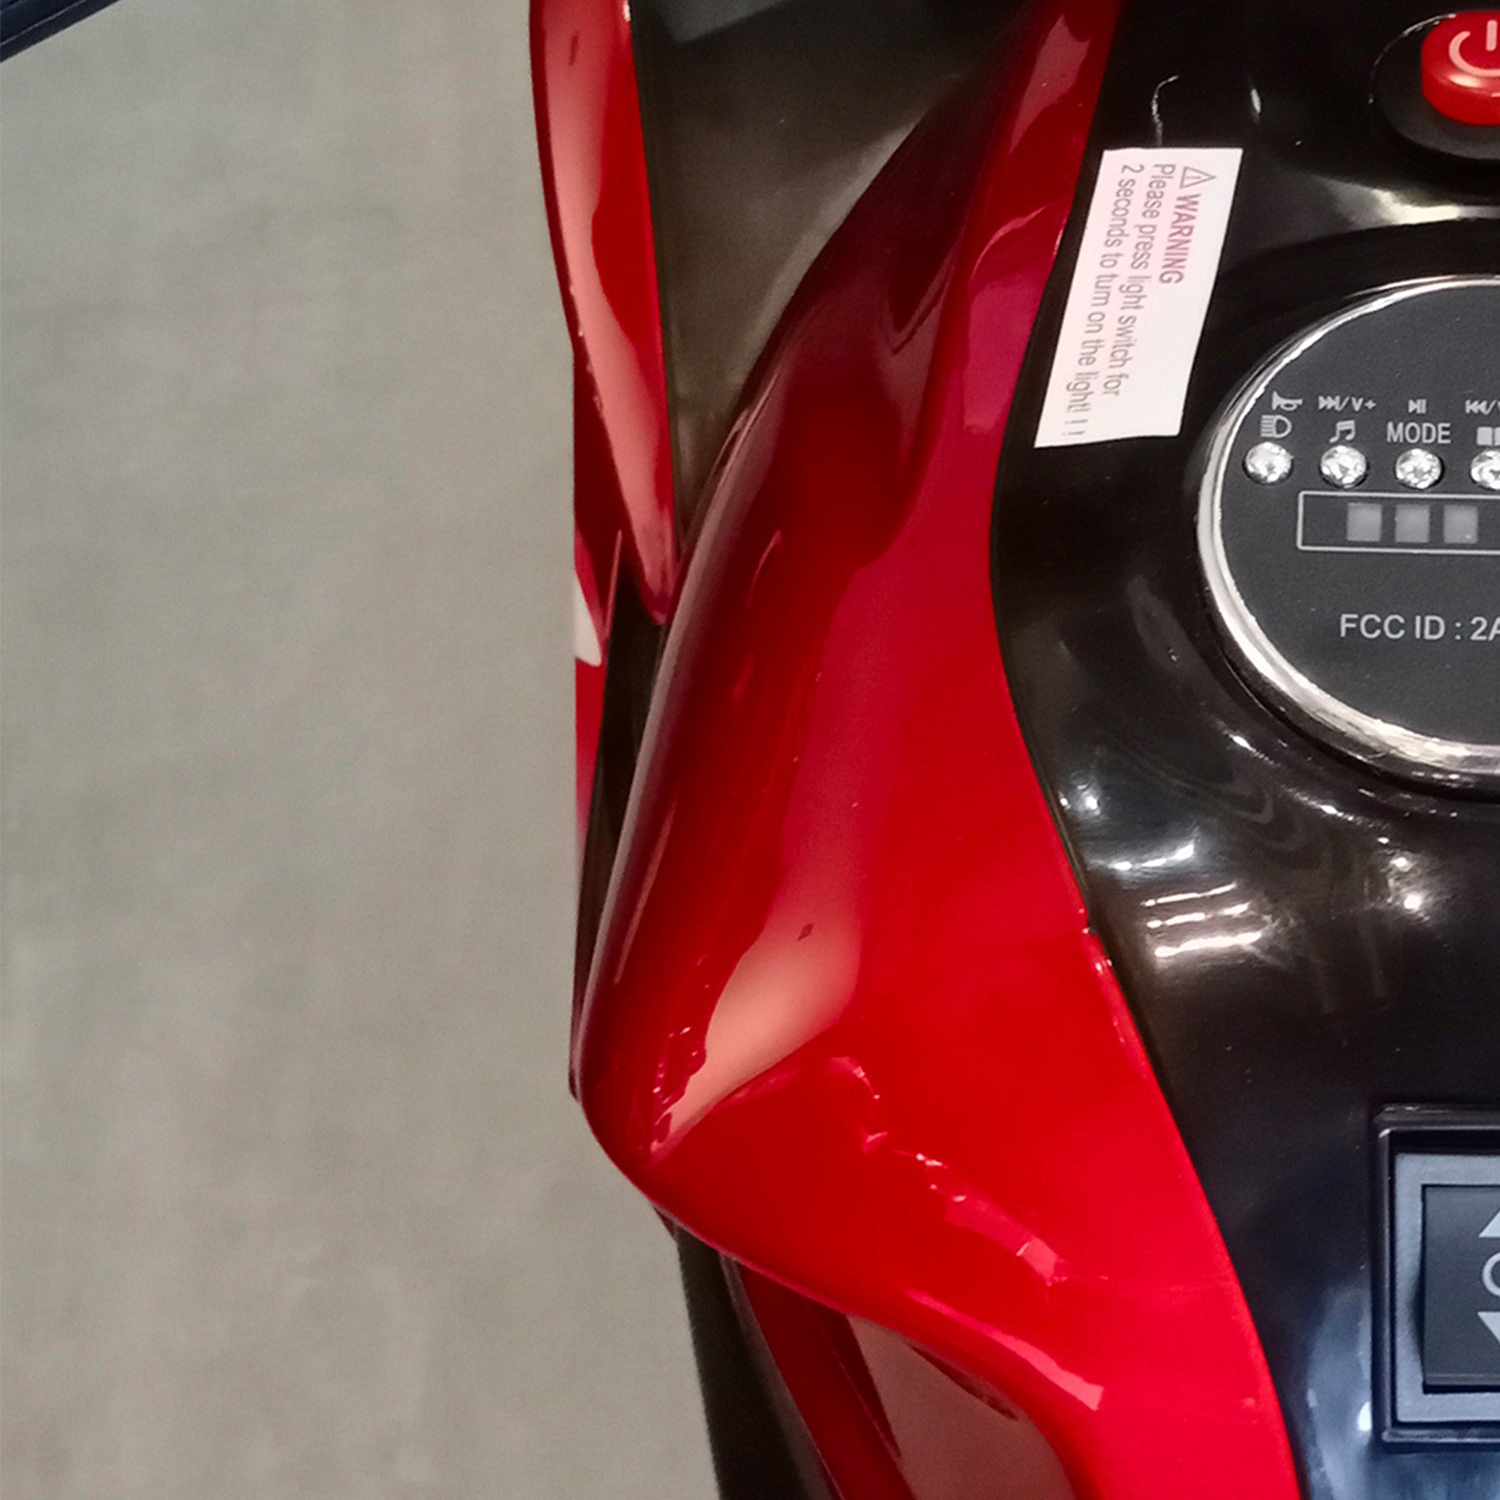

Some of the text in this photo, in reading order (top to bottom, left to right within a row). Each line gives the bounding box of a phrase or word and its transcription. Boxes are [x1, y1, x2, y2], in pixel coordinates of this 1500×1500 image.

[1121, 164, 1145, 174] 2
[1104, 178, 1136, 248] seconds
[1159, 193, 1202, 284] WARNING
[1100, 252, 1124, 269] to
[1090, 273, 1119, 307] turn
[1102, 163, 1176, 396] Please press light switch for
[1084, 311, 1106, 334] on
[1078, 339, 1105, 366] the
[1386, 421, 1451, 444] MODE
[1340, 613, 1405, 639] FCC
[1415, 615, 1445, 640] ID
